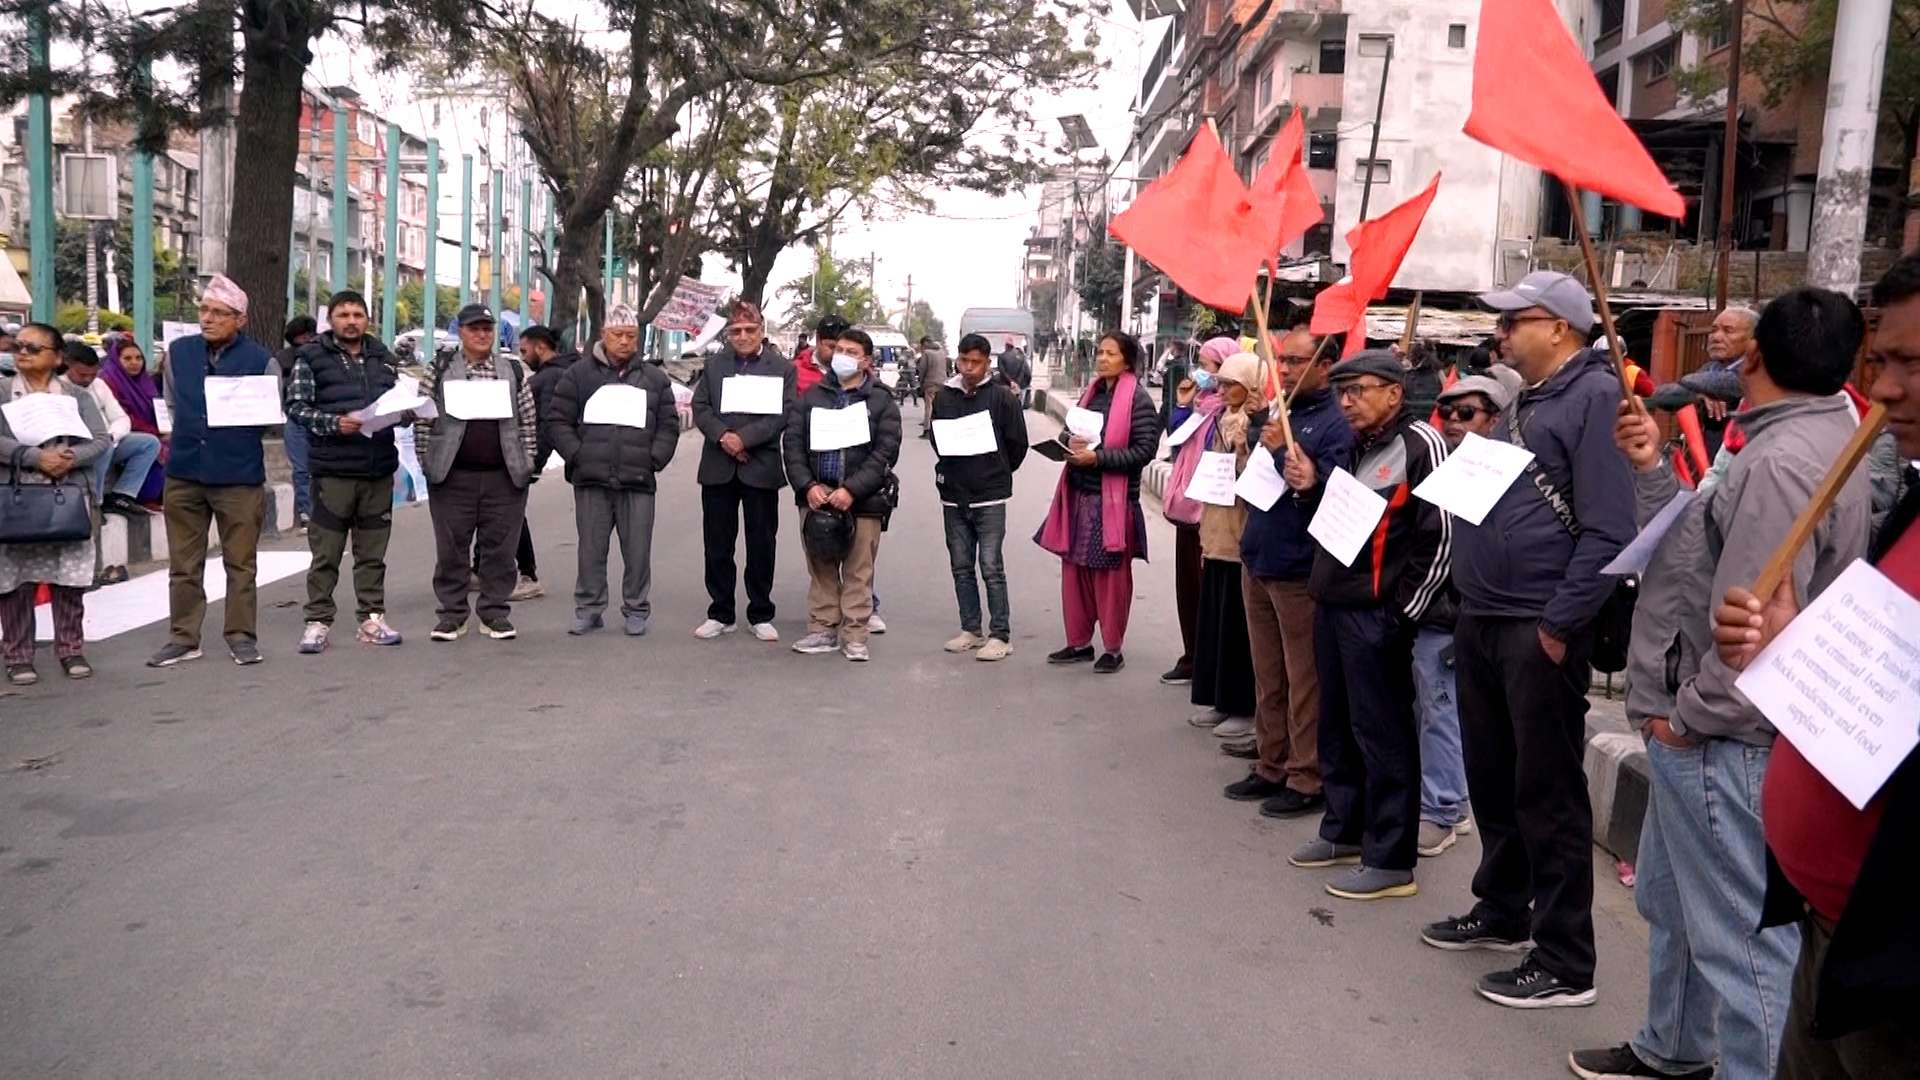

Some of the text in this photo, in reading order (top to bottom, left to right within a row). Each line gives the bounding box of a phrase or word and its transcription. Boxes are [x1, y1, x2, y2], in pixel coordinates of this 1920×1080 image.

[1792, 648, 1884, 727] government that even
[1827, 646, 1866, 677] criminal
[1864, 672, 1898, 704] Israeli
[1796, 679, 1834, 718] medicines
[1834, 717, 1858, 735] and
[1854, 729, 1882, 756] food
